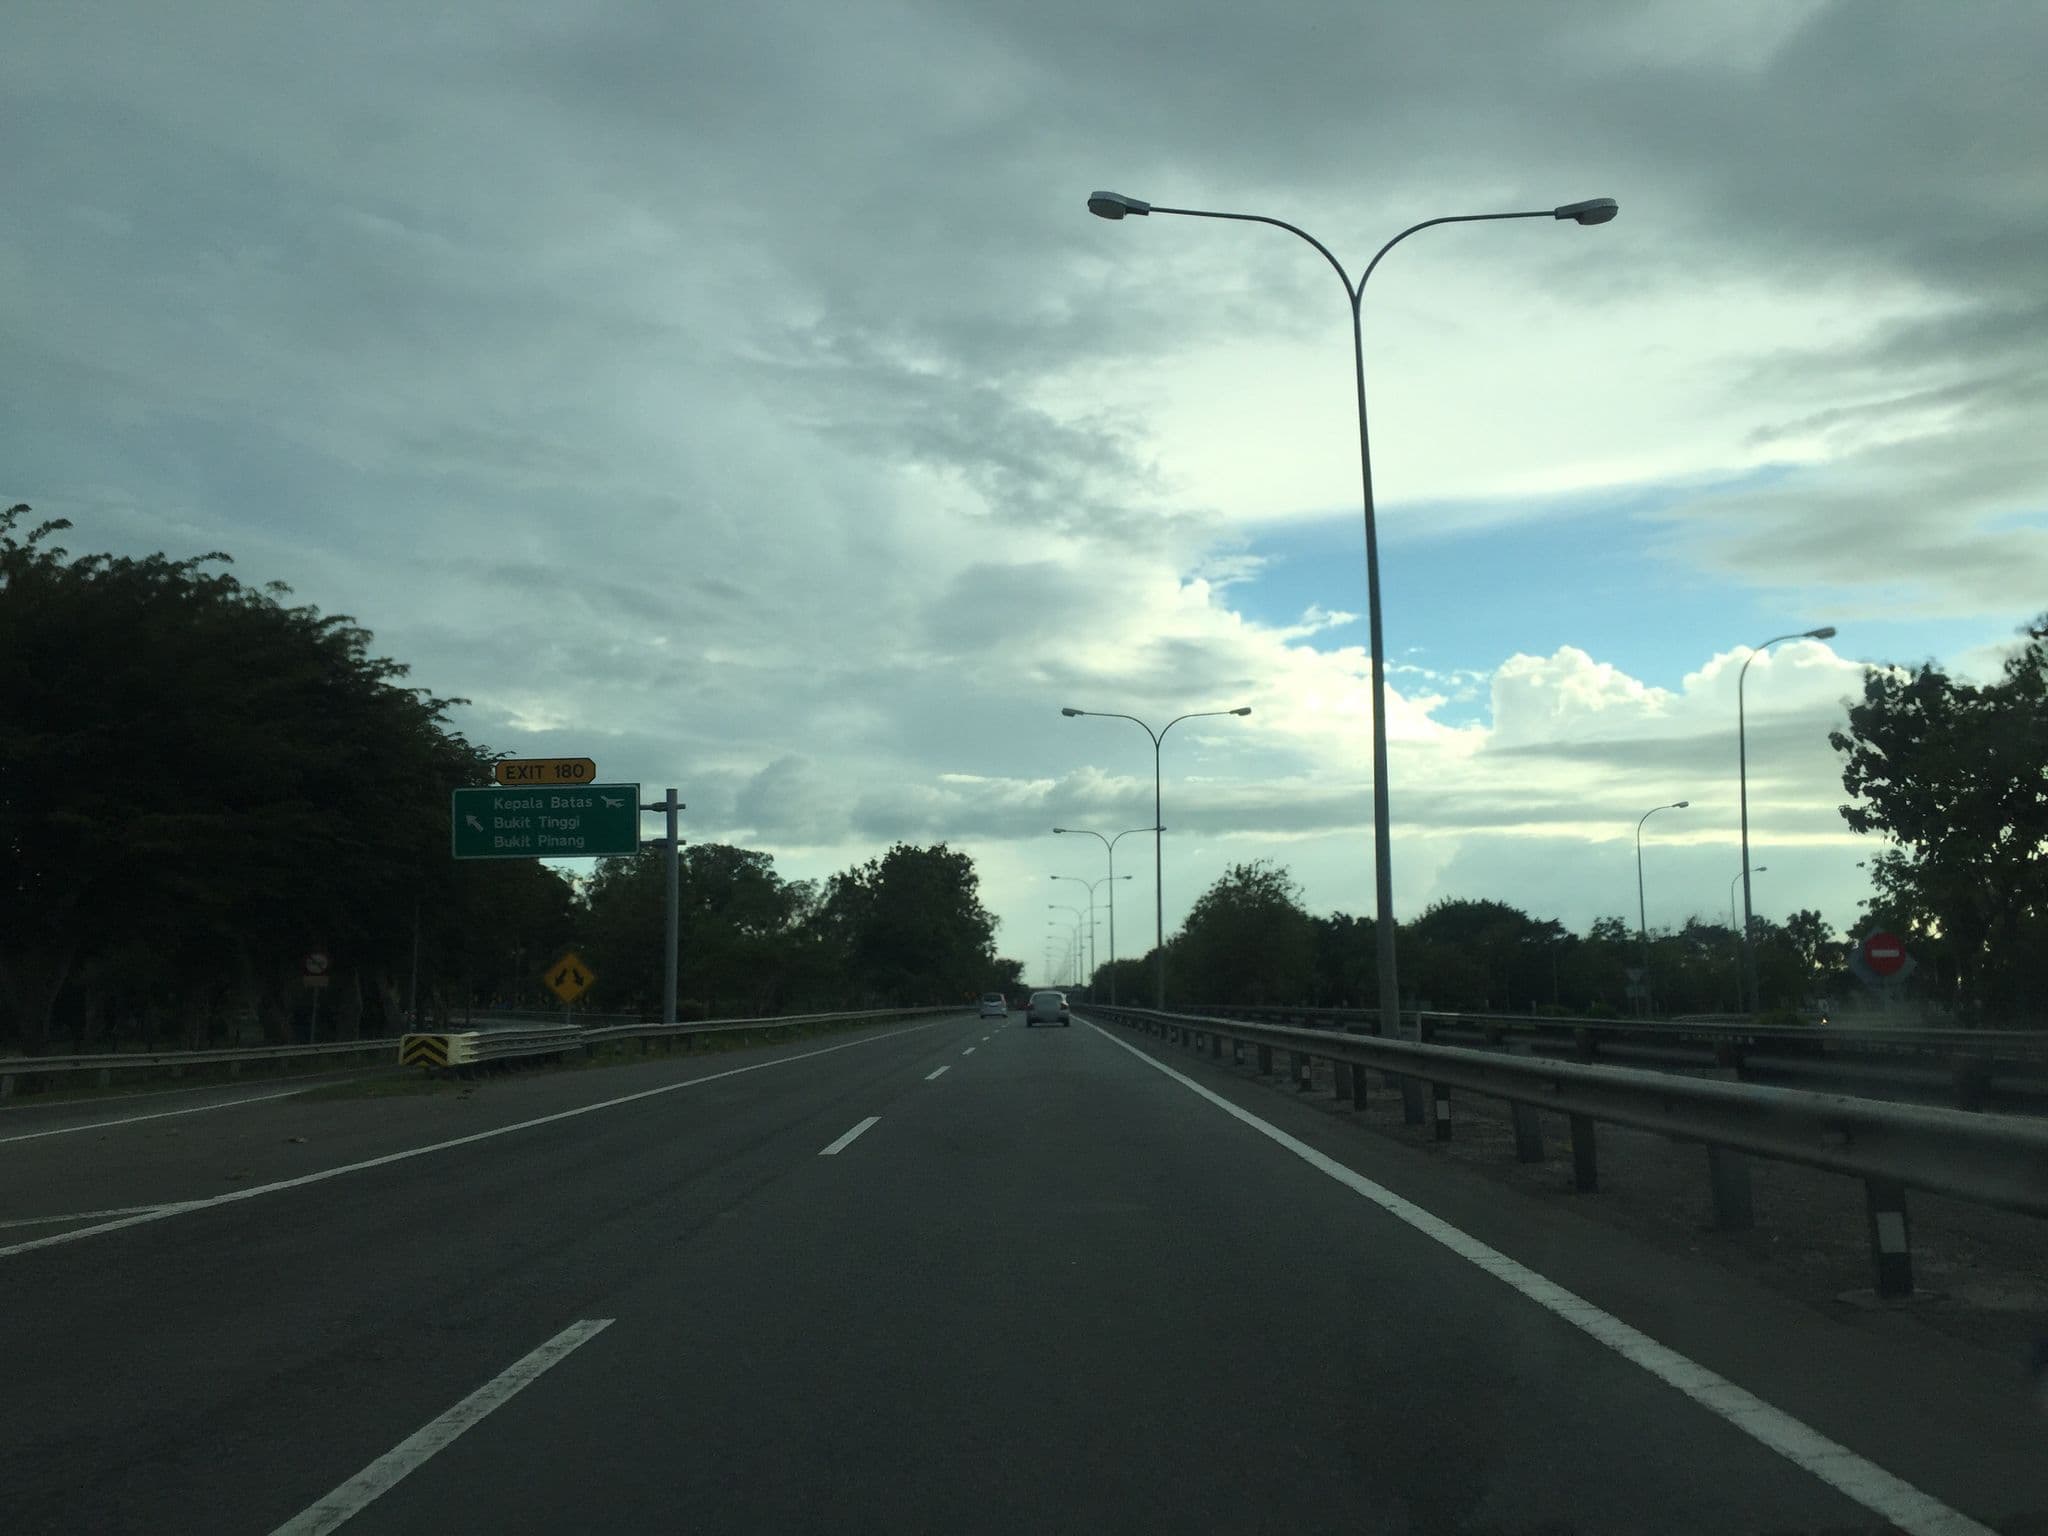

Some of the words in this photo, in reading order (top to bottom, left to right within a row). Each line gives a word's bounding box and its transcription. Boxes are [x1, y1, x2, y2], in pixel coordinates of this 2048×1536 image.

[506, 764, 545, 780] EXIT
[555, 763, 584, 778] 180
[494, 797, 543, 811] Kepala
[551, 795, 592, 808] Batas
[494, 816, 530, 829] Bukit
[538, 815, 580, 830] Tinggi
[494, 835, 530, 848] Bukit
[538, 834, 585, 848] Pinang
